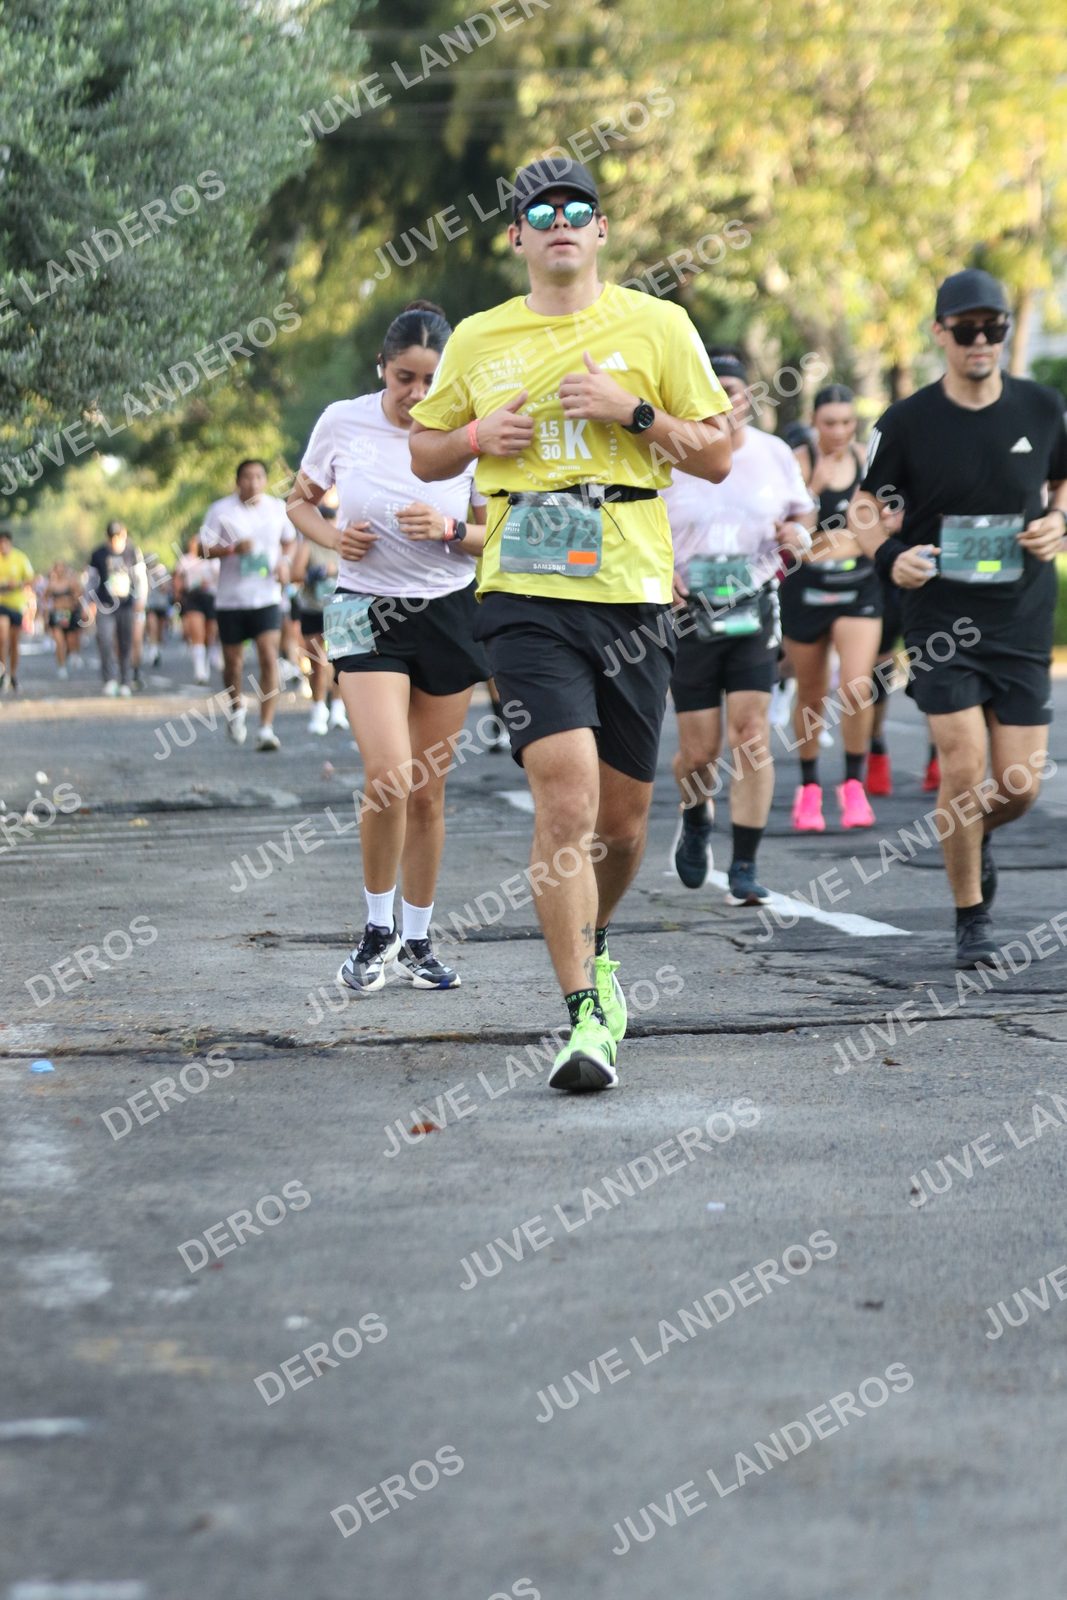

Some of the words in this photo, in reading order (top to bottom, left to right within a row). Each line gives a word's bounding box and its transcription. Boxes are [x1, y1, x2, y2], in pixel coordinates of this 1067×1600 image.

[539, 420, 560, 438] 15
[564, 419, 593, 460] K
[541, 444, 561, 460] 30
